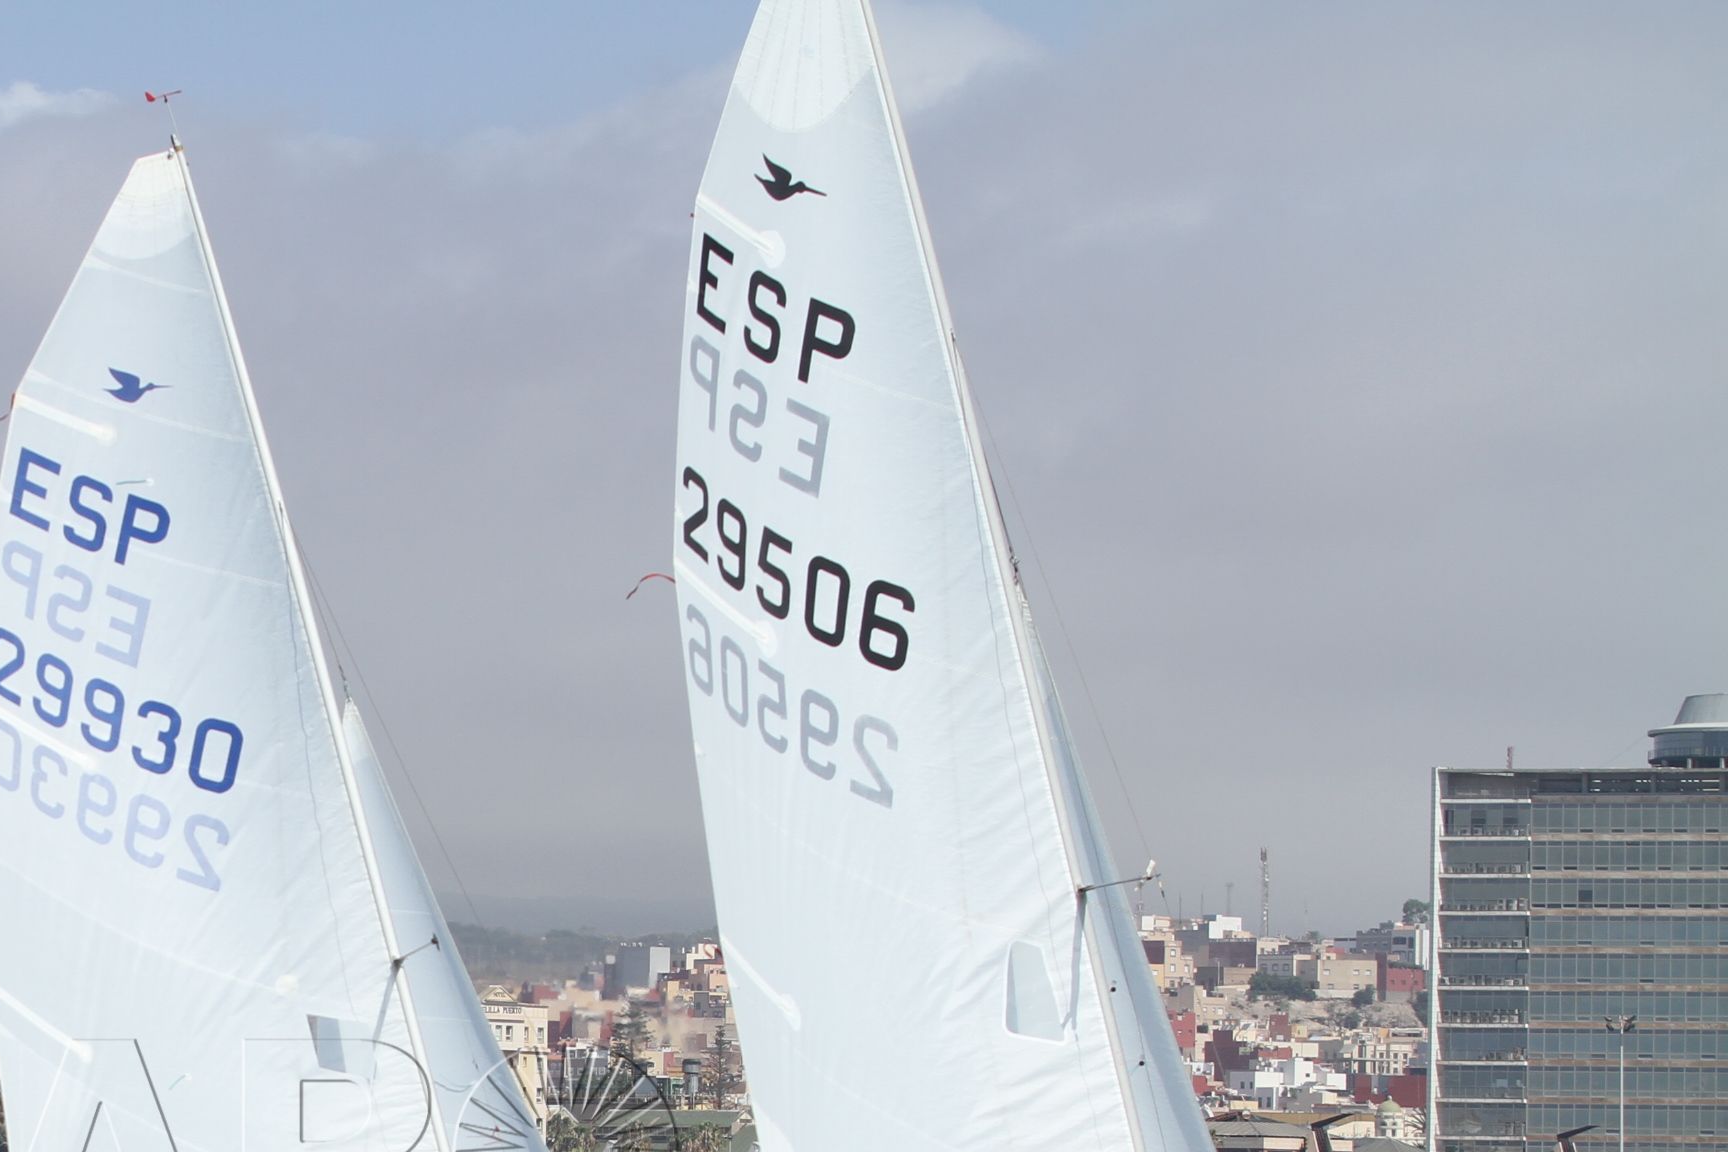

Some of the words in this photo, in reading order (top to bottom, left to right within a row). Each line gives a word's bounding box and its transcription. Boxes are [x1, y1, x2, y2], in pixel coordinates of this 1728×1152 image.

[695, 232, 856, 384] ESP
[8, 447, 171, 566] ESP
[682, 466, 916, 672] 29506
